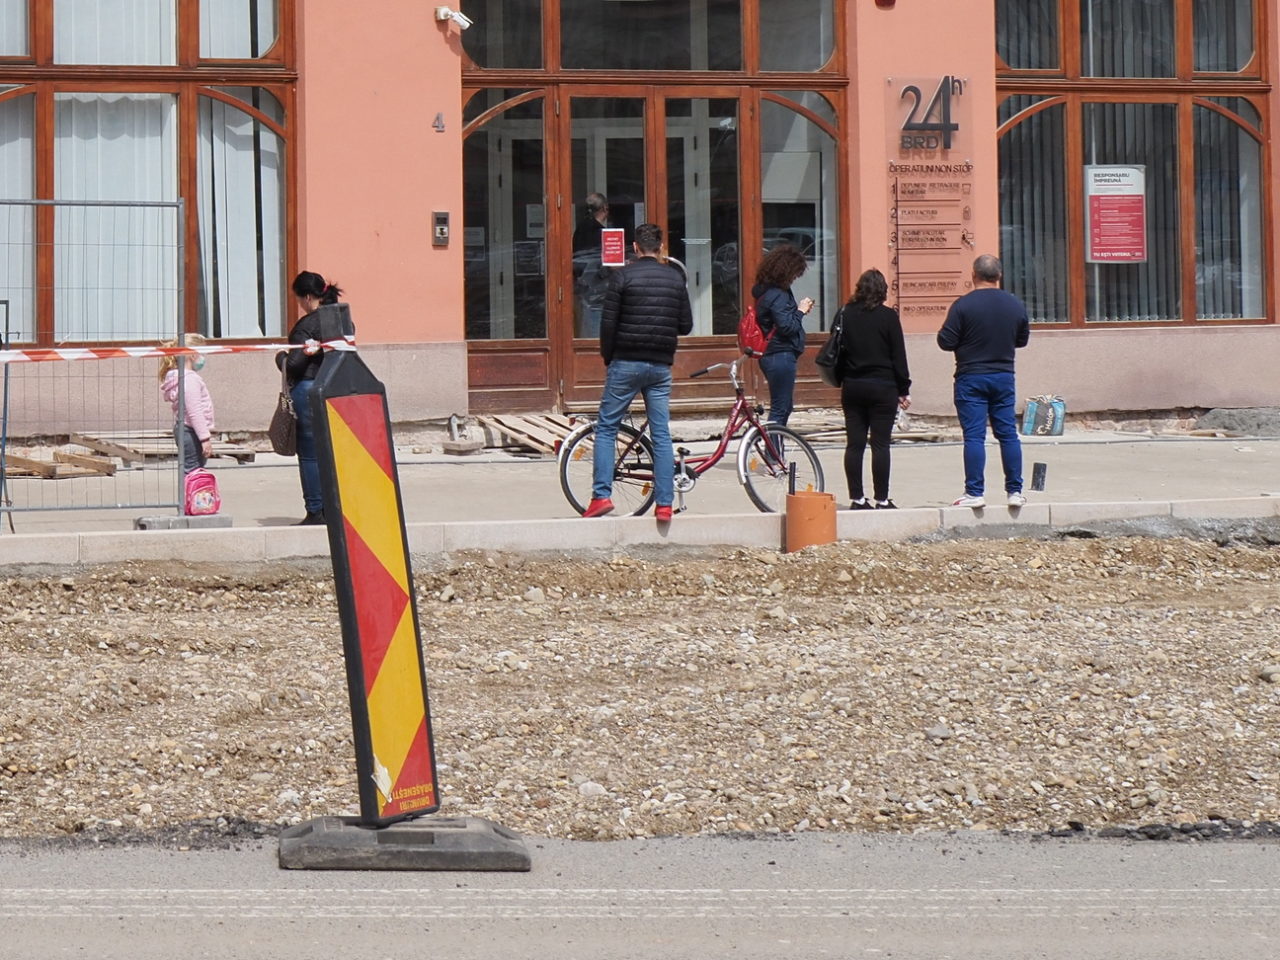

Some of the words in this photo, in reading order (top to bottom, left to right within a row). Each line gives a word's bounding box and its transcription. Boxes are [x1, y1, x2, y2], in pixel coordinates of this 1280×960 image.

[431, 111, 445, 133] 4
[901, 76, 963, 150] 24h
[901, 135, 939, 150] BRD
[934, 164, 952, 173] NON
[953, 164, 973, 173] STOP
